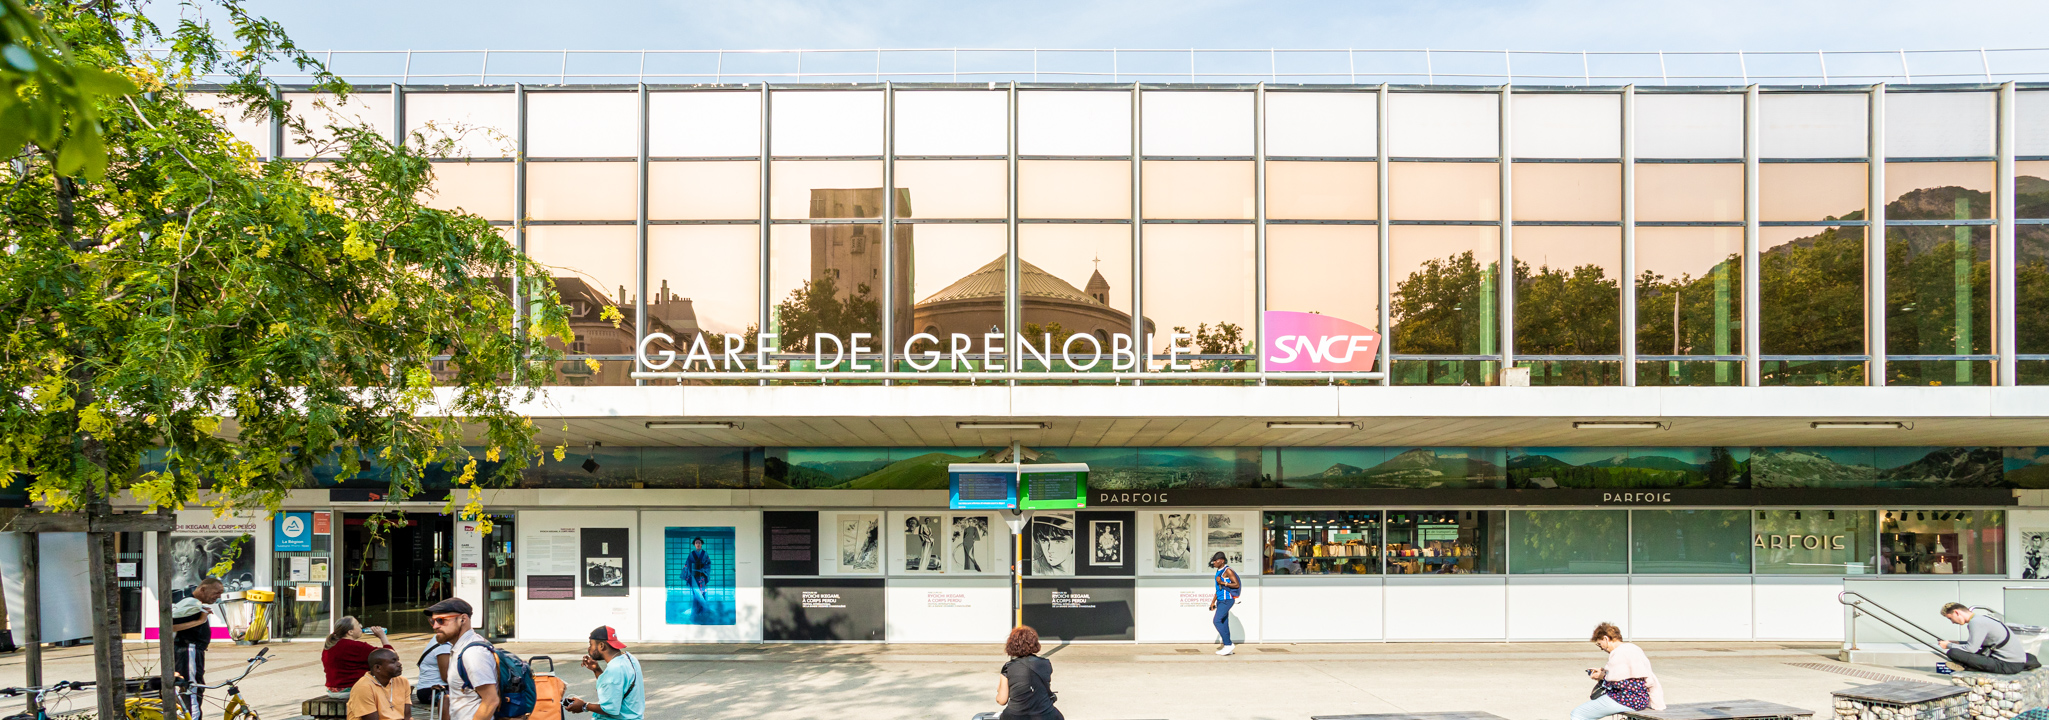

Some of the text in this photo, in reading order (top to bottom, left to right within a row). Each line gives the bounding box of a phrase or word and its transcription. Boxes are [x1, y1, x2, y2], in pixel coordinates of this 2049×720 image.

[639, 332, 1191, 371] GARE DE GRENOBLE
[1269, 334, 1374, 364] SNCF
[1100, 493, 1168, 503] PARFOIS
[1603, 492, 1671, 502] PARFOIS
[1754, 534, 1845, 549] ARFOIS
